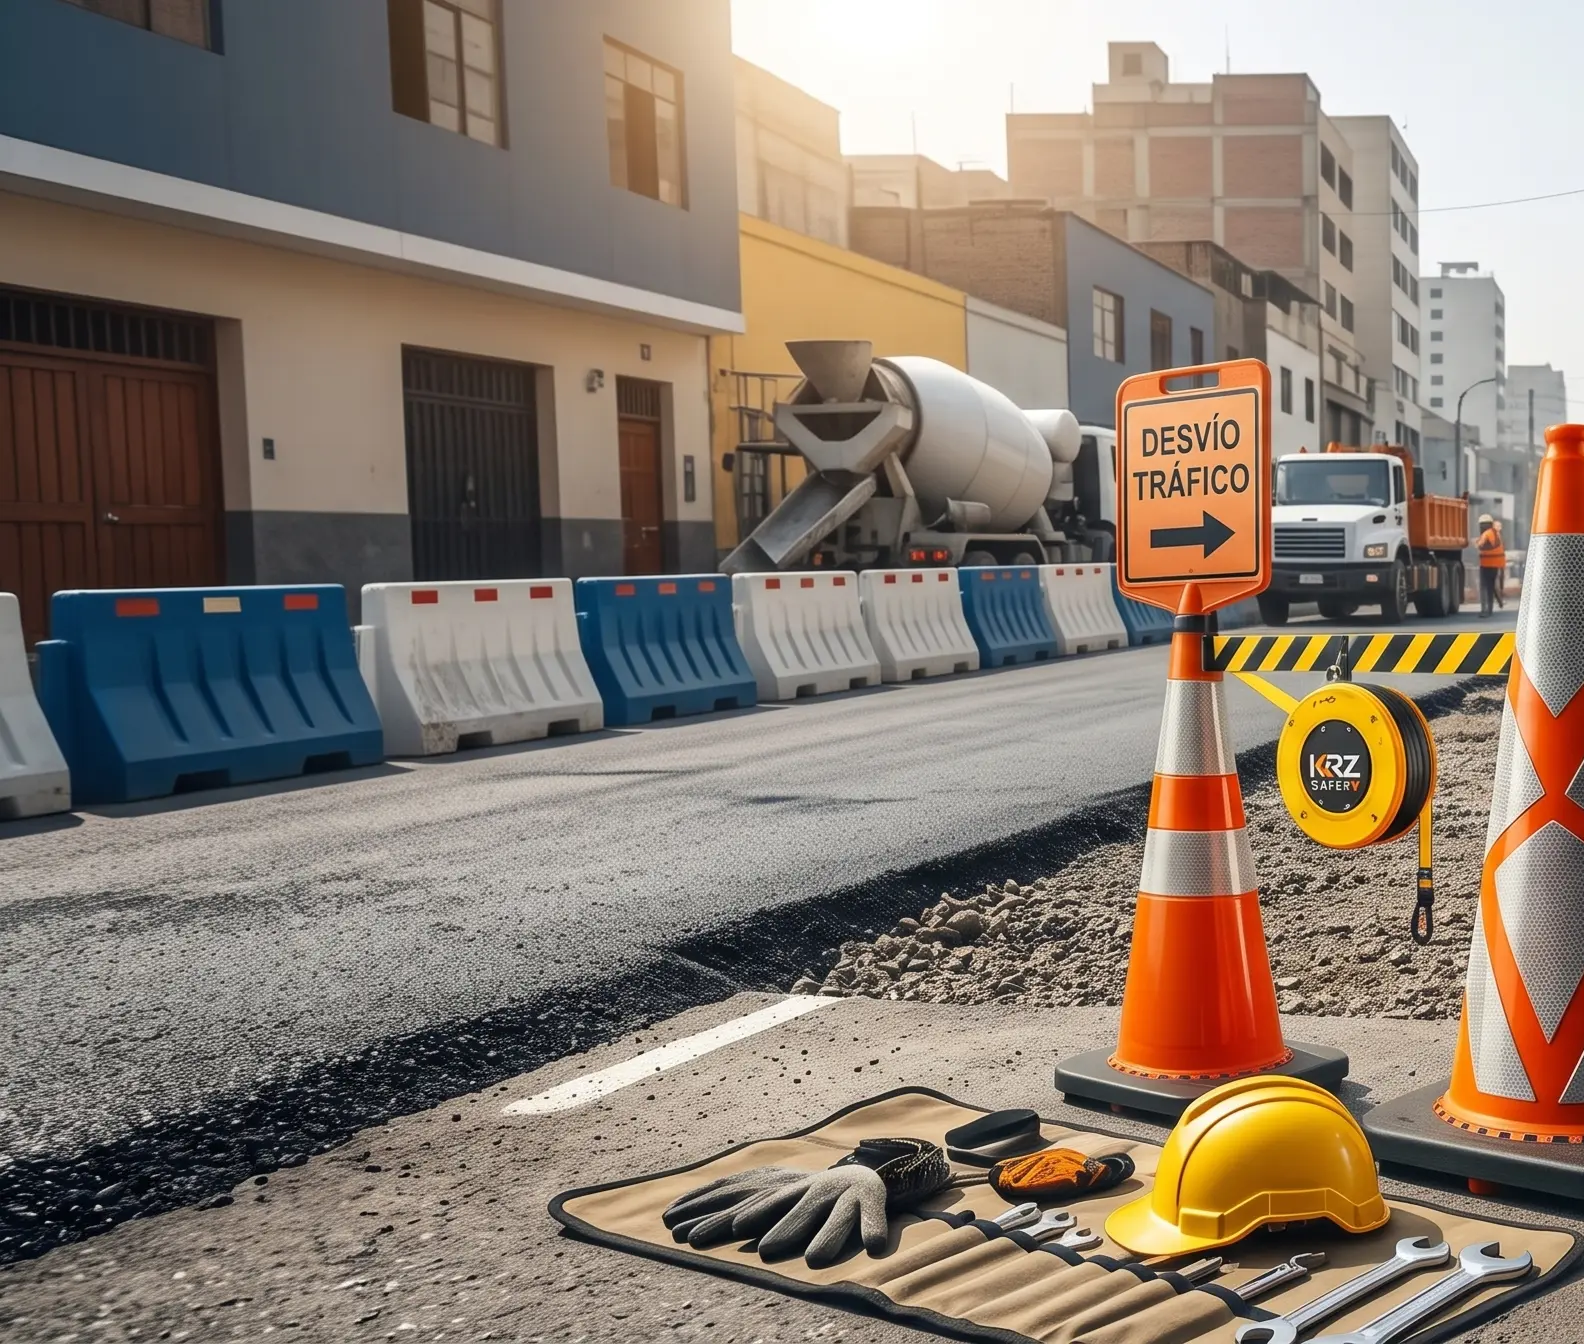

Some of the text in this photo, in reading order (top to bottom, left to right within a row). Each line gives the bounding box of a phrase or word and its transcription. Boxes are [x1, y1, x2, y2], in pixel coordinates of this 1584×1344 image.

[1142, 413, 1240, 457] DESVÍO
[1133, 461, 1249, 500] TRÁFICO
[1309, 754, 1361, 778] KRZ
